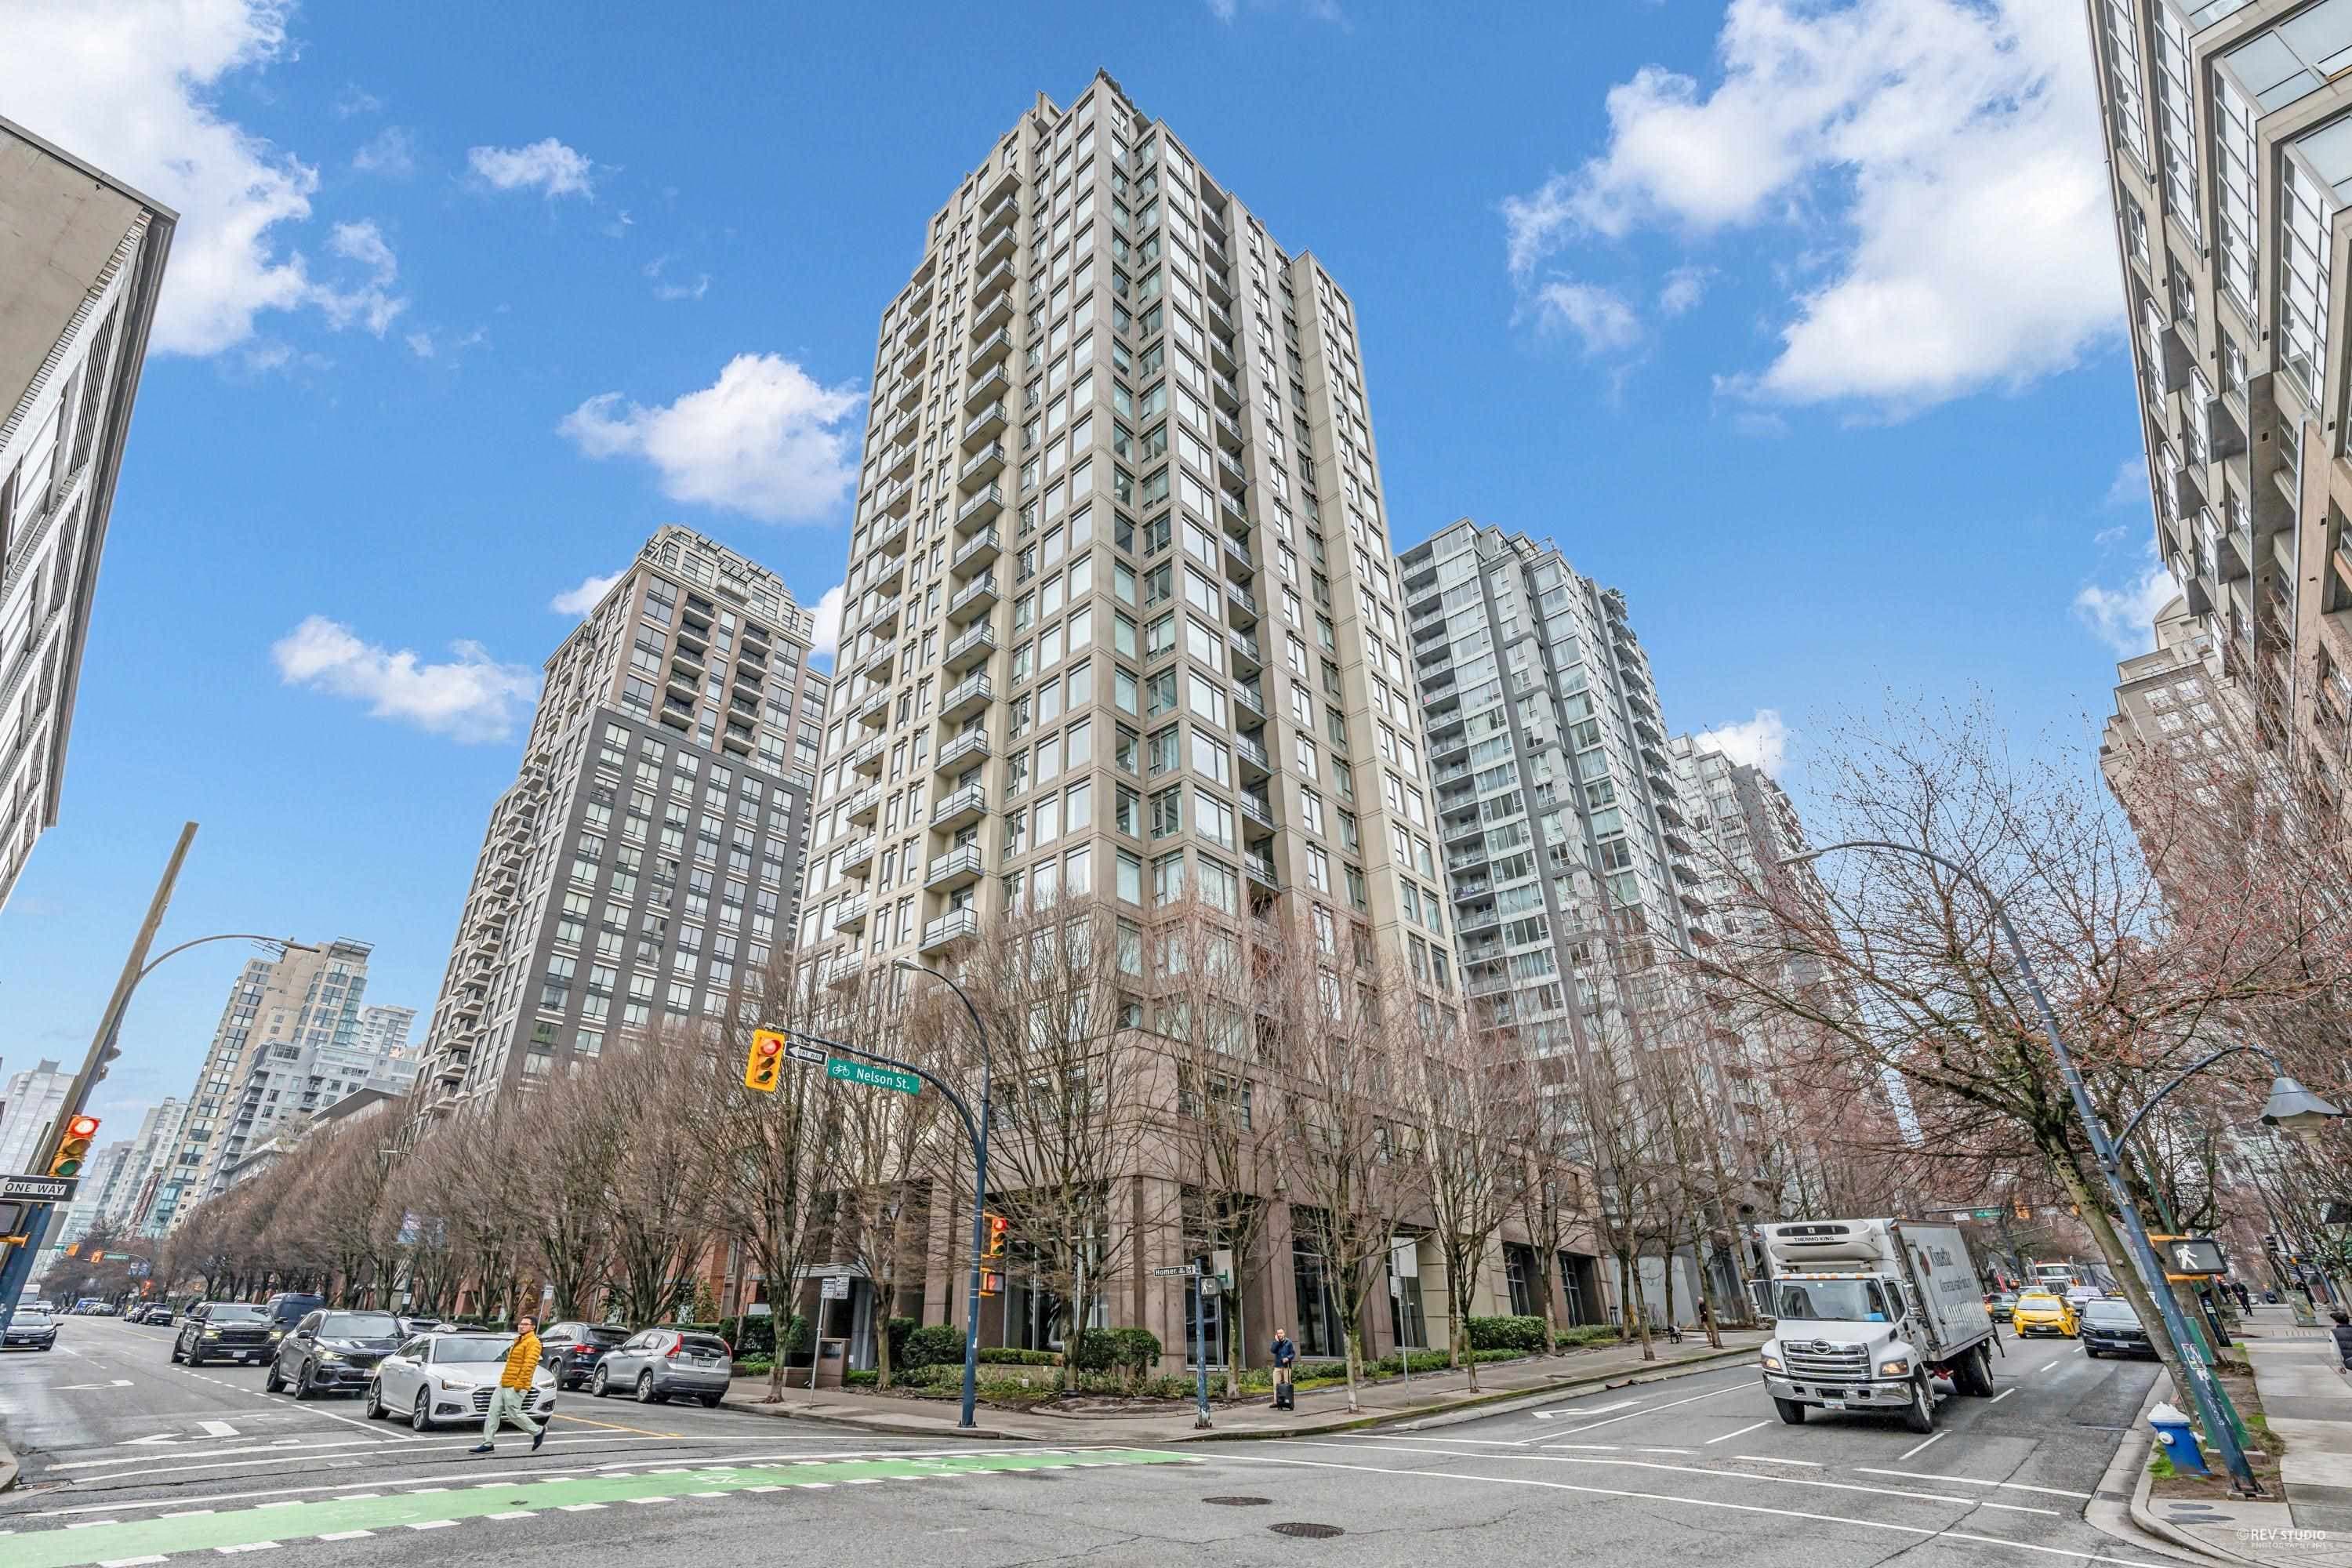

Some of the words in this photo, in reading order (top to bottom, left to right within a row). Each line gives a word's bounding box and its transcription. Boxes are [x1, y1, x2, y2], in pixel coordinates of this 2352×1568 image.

[856, 1068, 893, 1086] Nelson
[895, 1077, 910, 1090] St.
[5, 1182, 32, 1192] ONE
[37, 1185, 64, 1194] WAY
